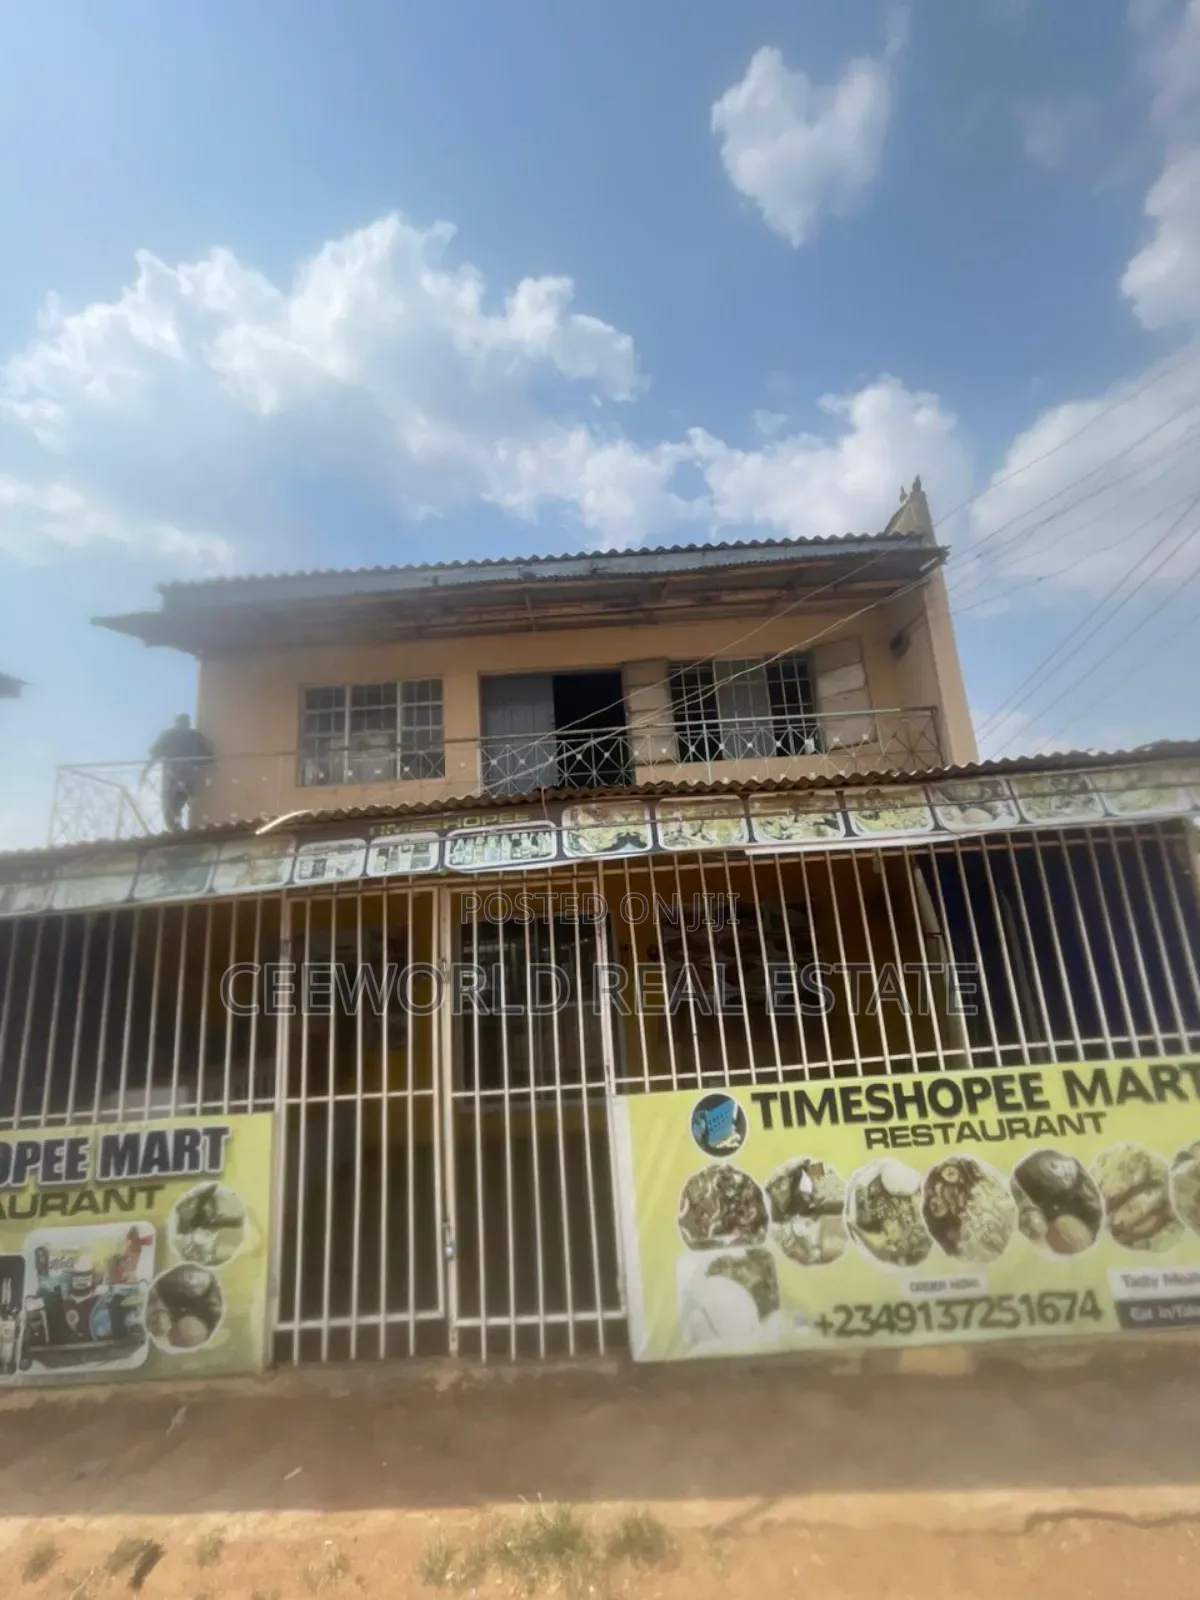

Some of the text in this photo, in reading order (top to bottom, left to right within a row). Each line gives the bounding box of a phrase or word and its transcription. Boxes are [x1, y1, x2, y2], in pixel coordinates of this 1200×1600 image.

[751, 1072, 1050, 1130] TIMESHOPEE
[1062, 1062, 1200, 1109] MART
[100, 1126, 229, 1179] MART
[864, 1111, 1107, 1151] RESTAURANT
[0, 1185, 164, 1220] URANT
[814, 1289, 1105, 1338] +2349137251674
